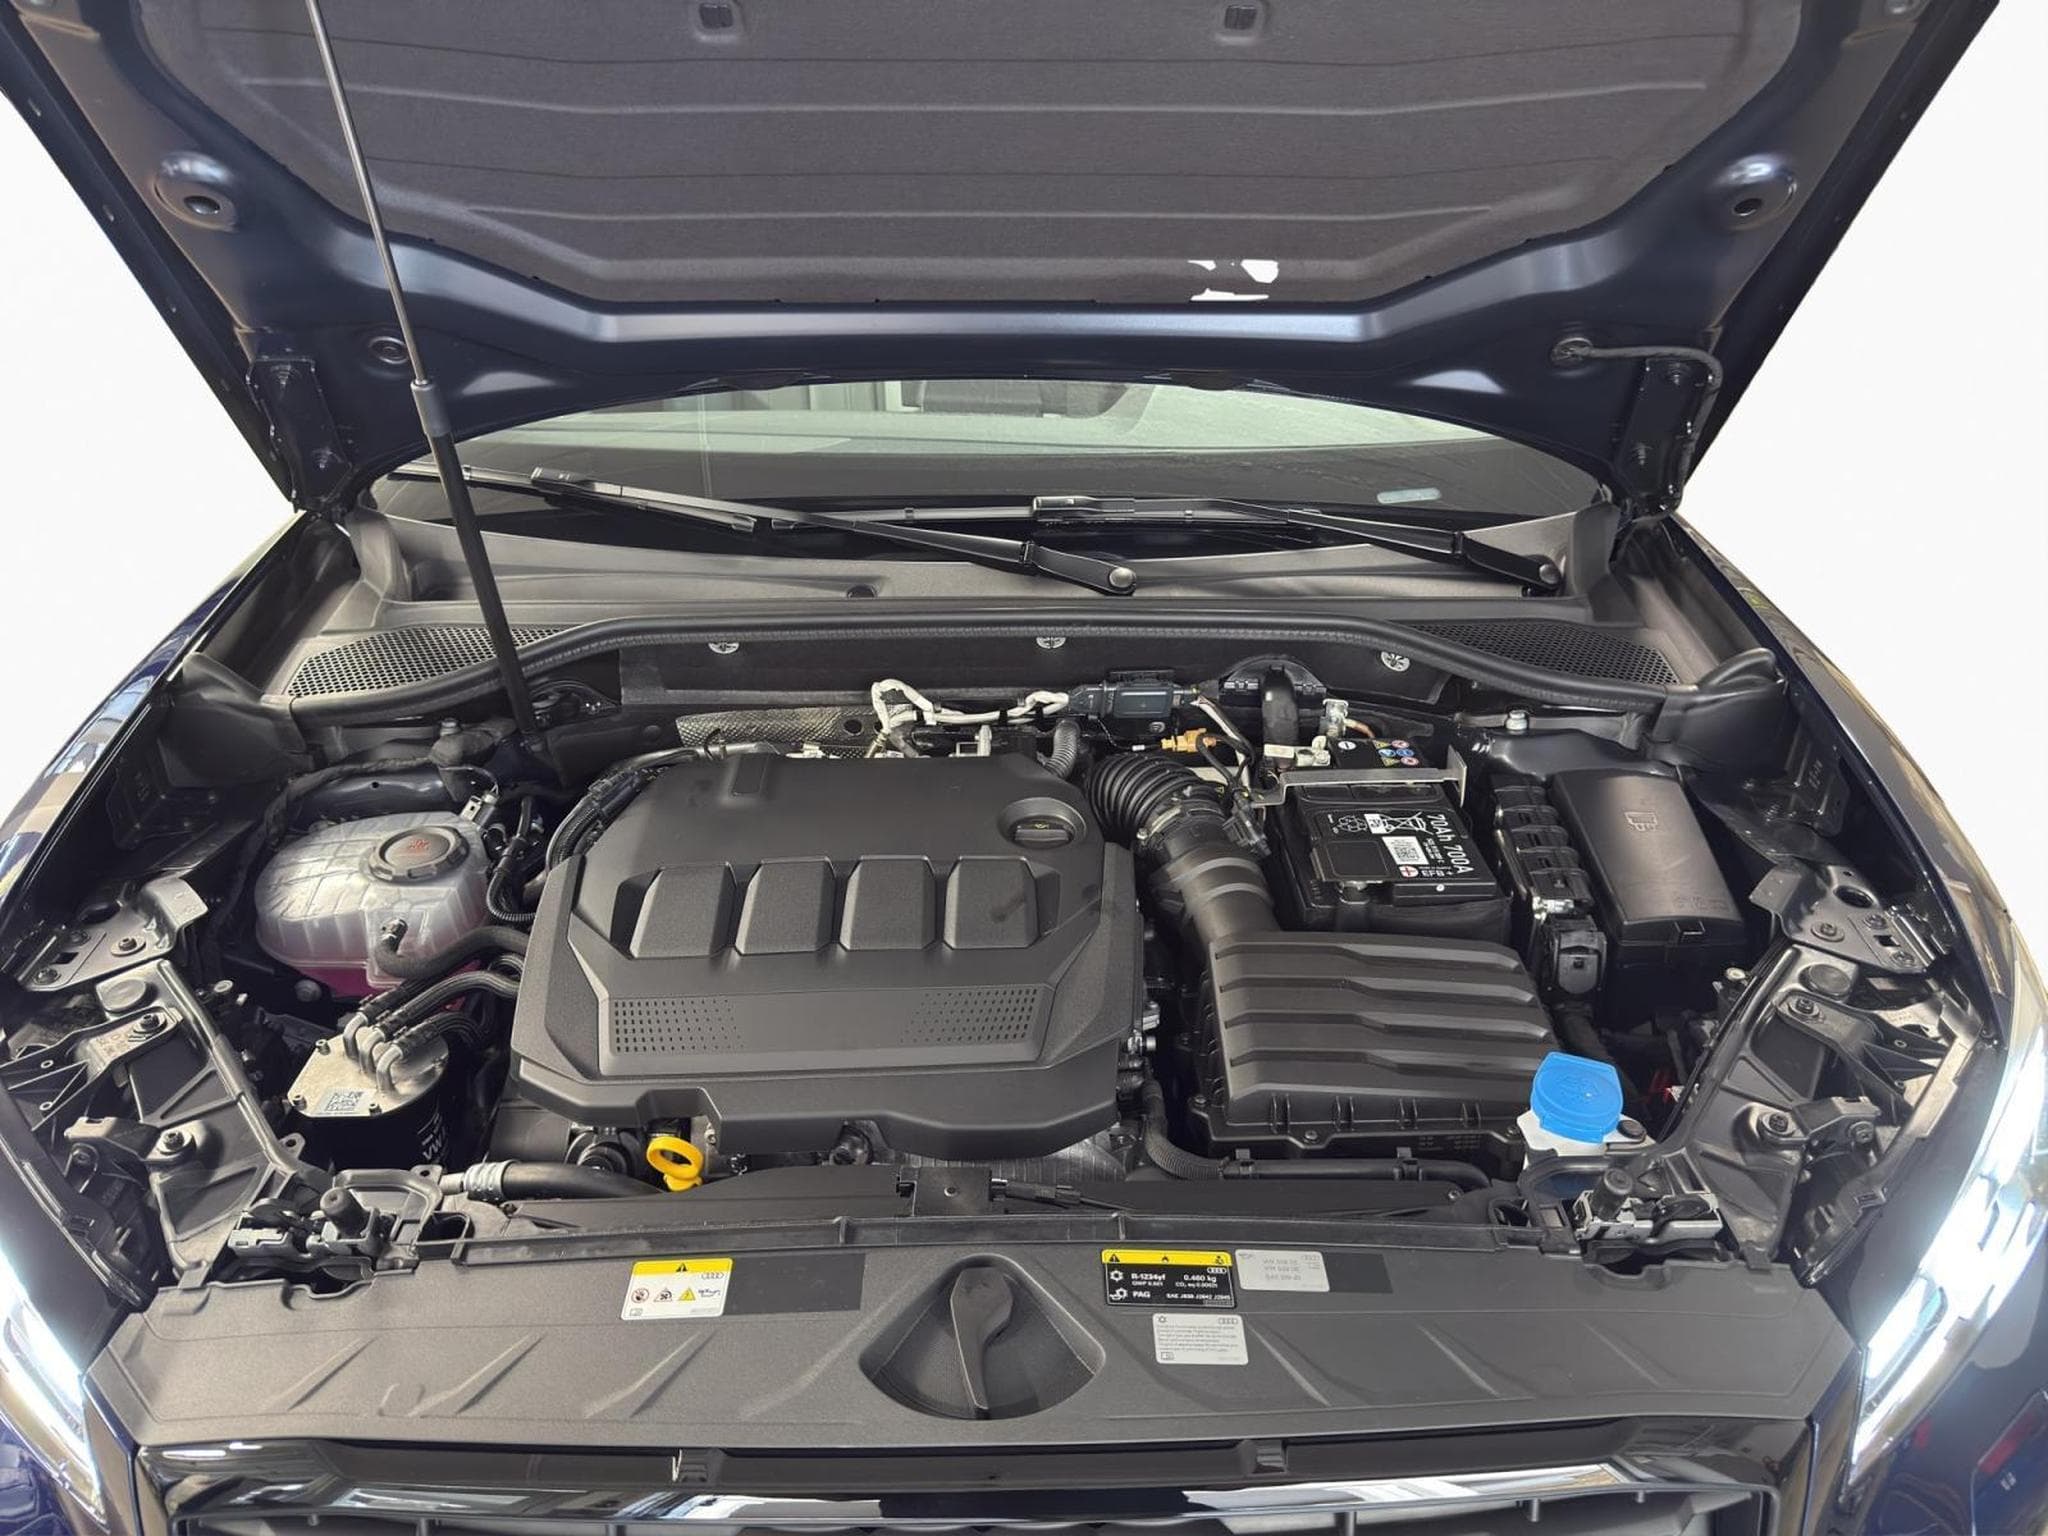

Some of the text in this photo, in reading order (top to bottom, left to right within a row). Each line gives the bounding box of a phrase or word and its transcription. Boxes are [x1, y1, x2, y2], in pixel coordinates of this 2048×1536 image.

[1426, 814, 1456, 841] 70Ah
[1443, 844, 1475, 873] 700A
[1131, 1272, 1166, 1281] R-1234yf
[1207, 1274, 1217, 1283] kg
[1132, 1290, 1151, 1298] PAG
